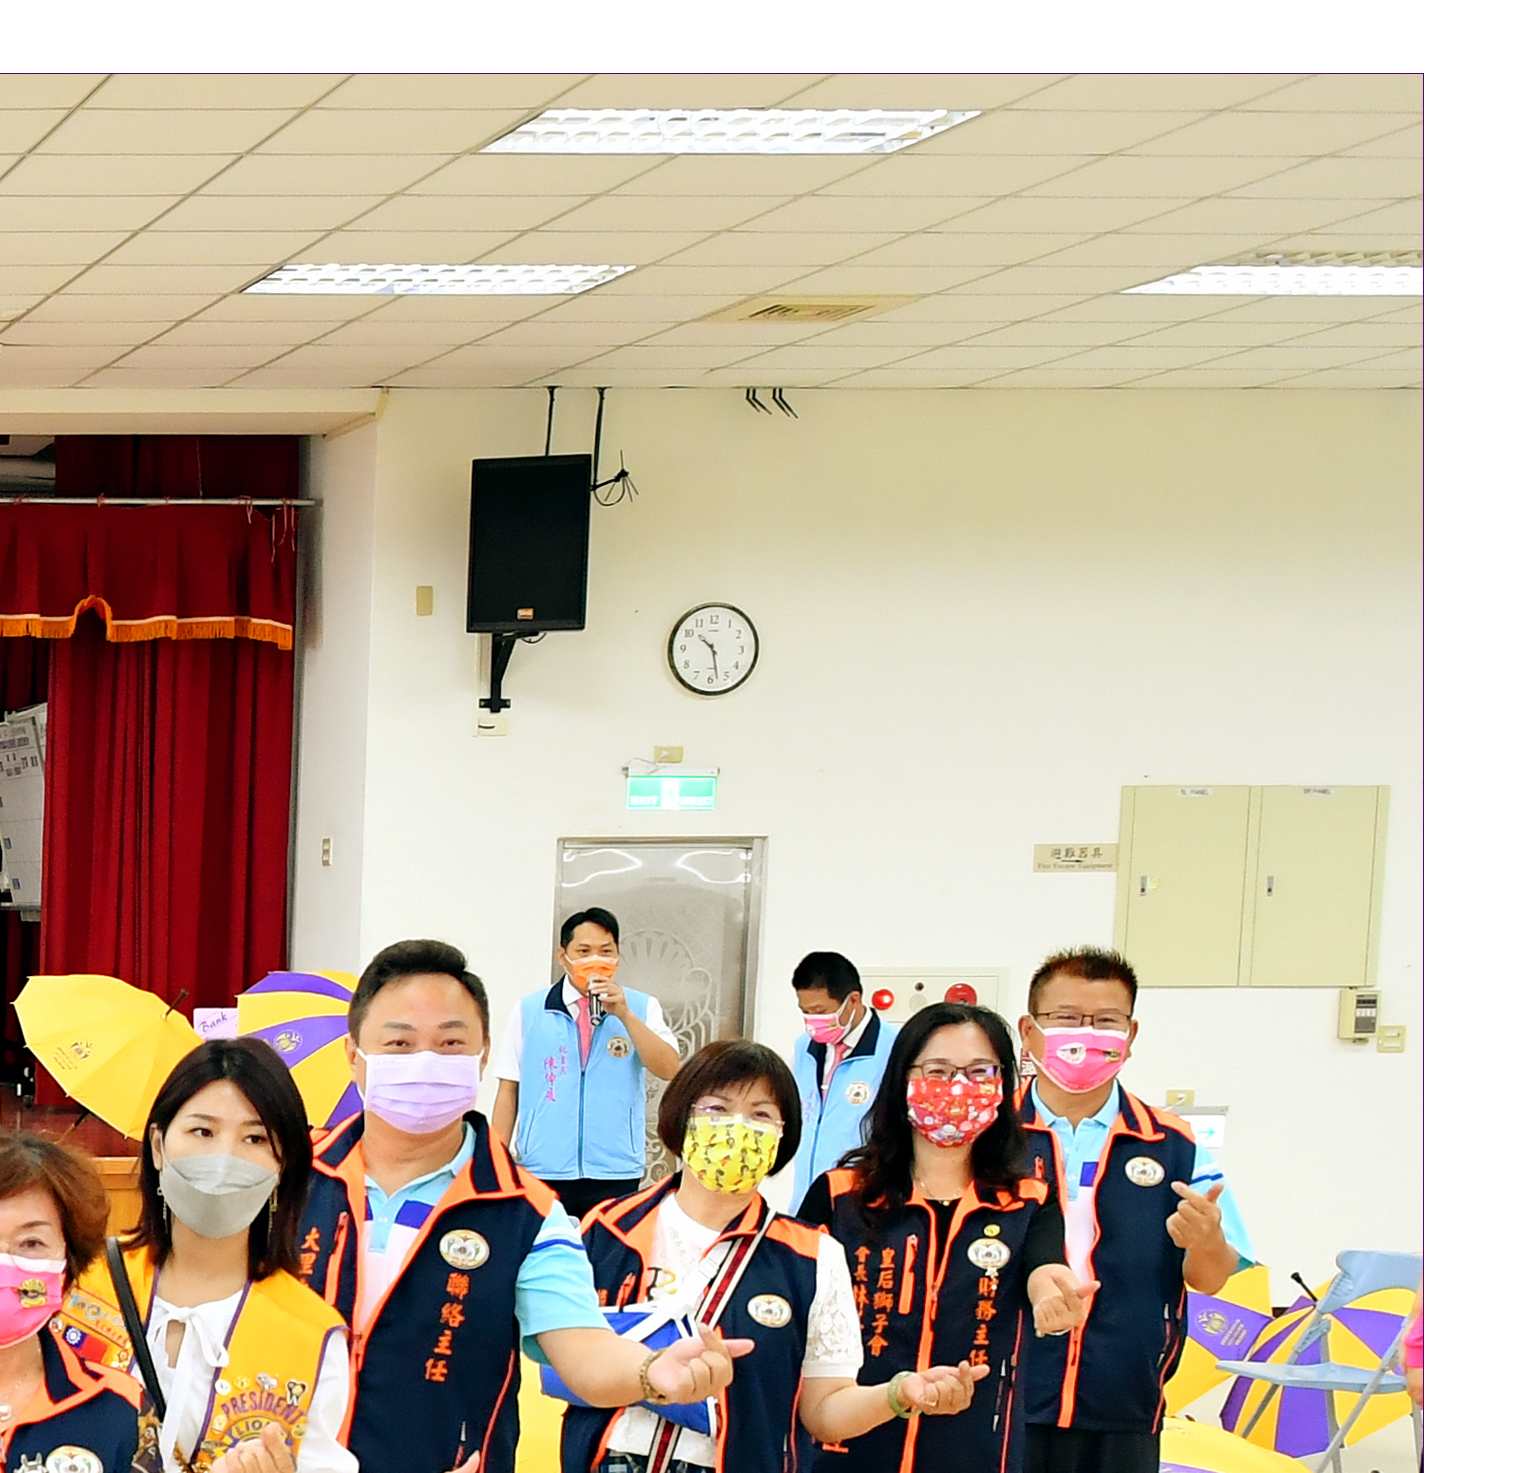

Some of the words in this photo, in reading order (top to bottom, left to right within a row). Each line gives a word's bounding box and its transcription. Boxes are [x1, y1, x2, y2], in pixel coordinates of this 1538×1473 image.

[201, 1012, 228, 1033] Bank
[298, 1226, 321, 1287] 大里
[424, 1271, 470, 1383] 聯絡主任
[867, 1247, 896, 1357] 皇后獅子會
[220, 1388, 308, 1425] PRESIDENT
